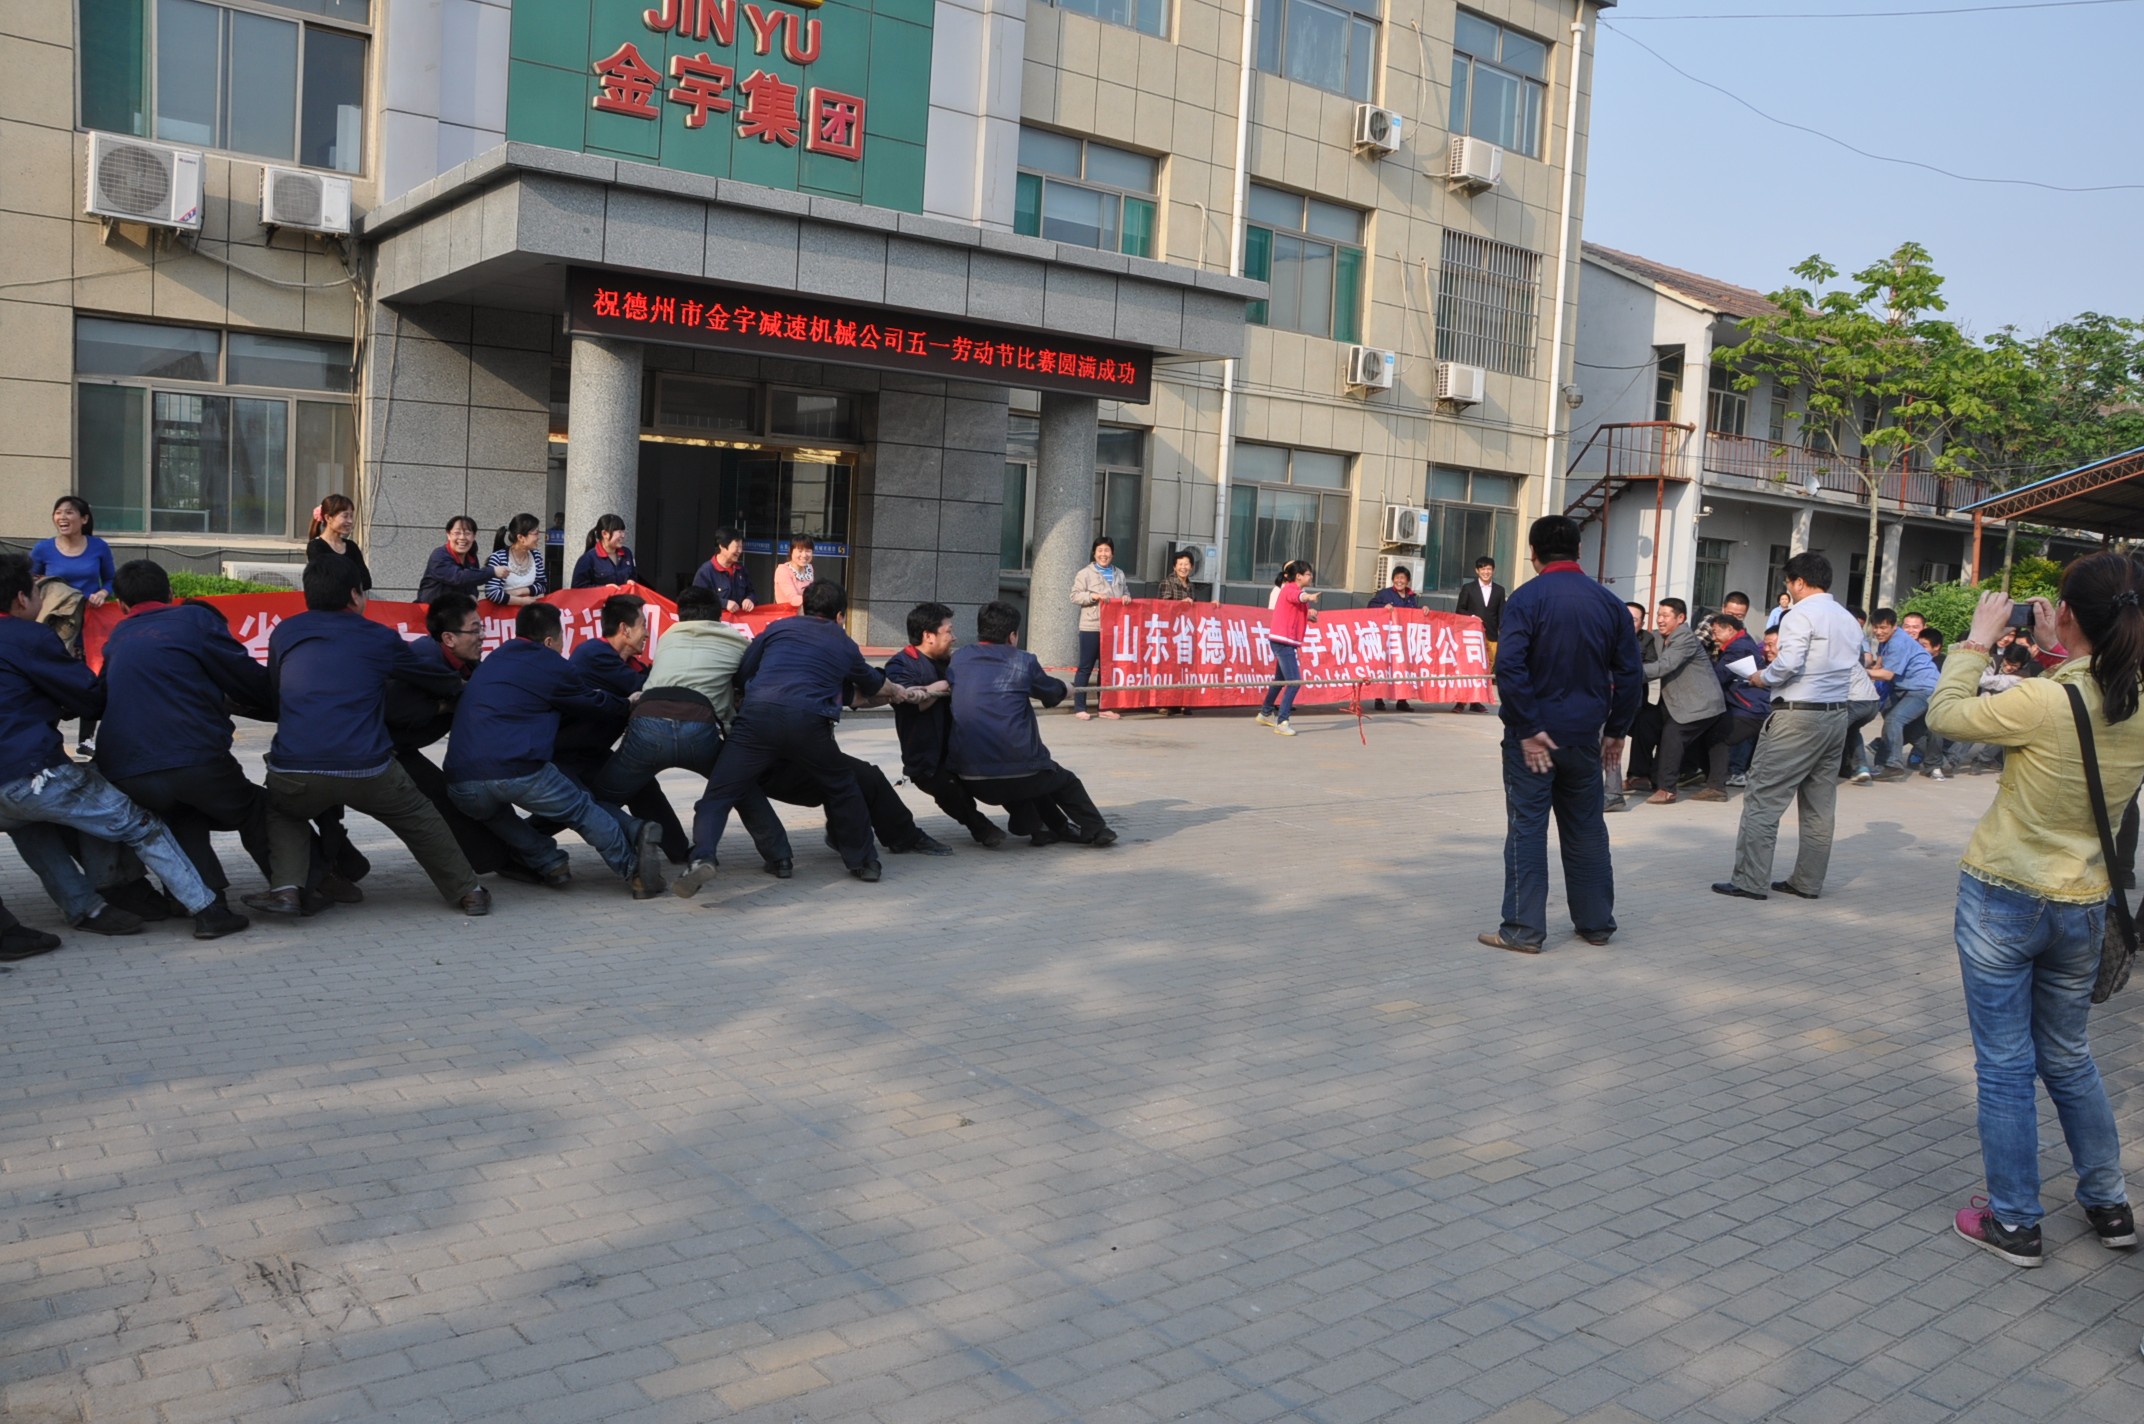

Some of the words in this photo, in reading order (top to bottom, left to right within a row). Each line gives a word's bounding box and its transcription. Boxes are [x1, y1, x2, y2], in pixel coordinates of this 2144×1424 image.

[593, 42, 865, 161] 金宇集团
[593, 287, 1136, 385] 祝德州市金宇减速机械公司五一劳动节比赛圆满成功
[1112, 613, 1487, 670] 山东省德州市宇机械有限公司
[1112, 667, 1173, 689] Dezhou
[1177, 667, 1219, 694] Jinyu
